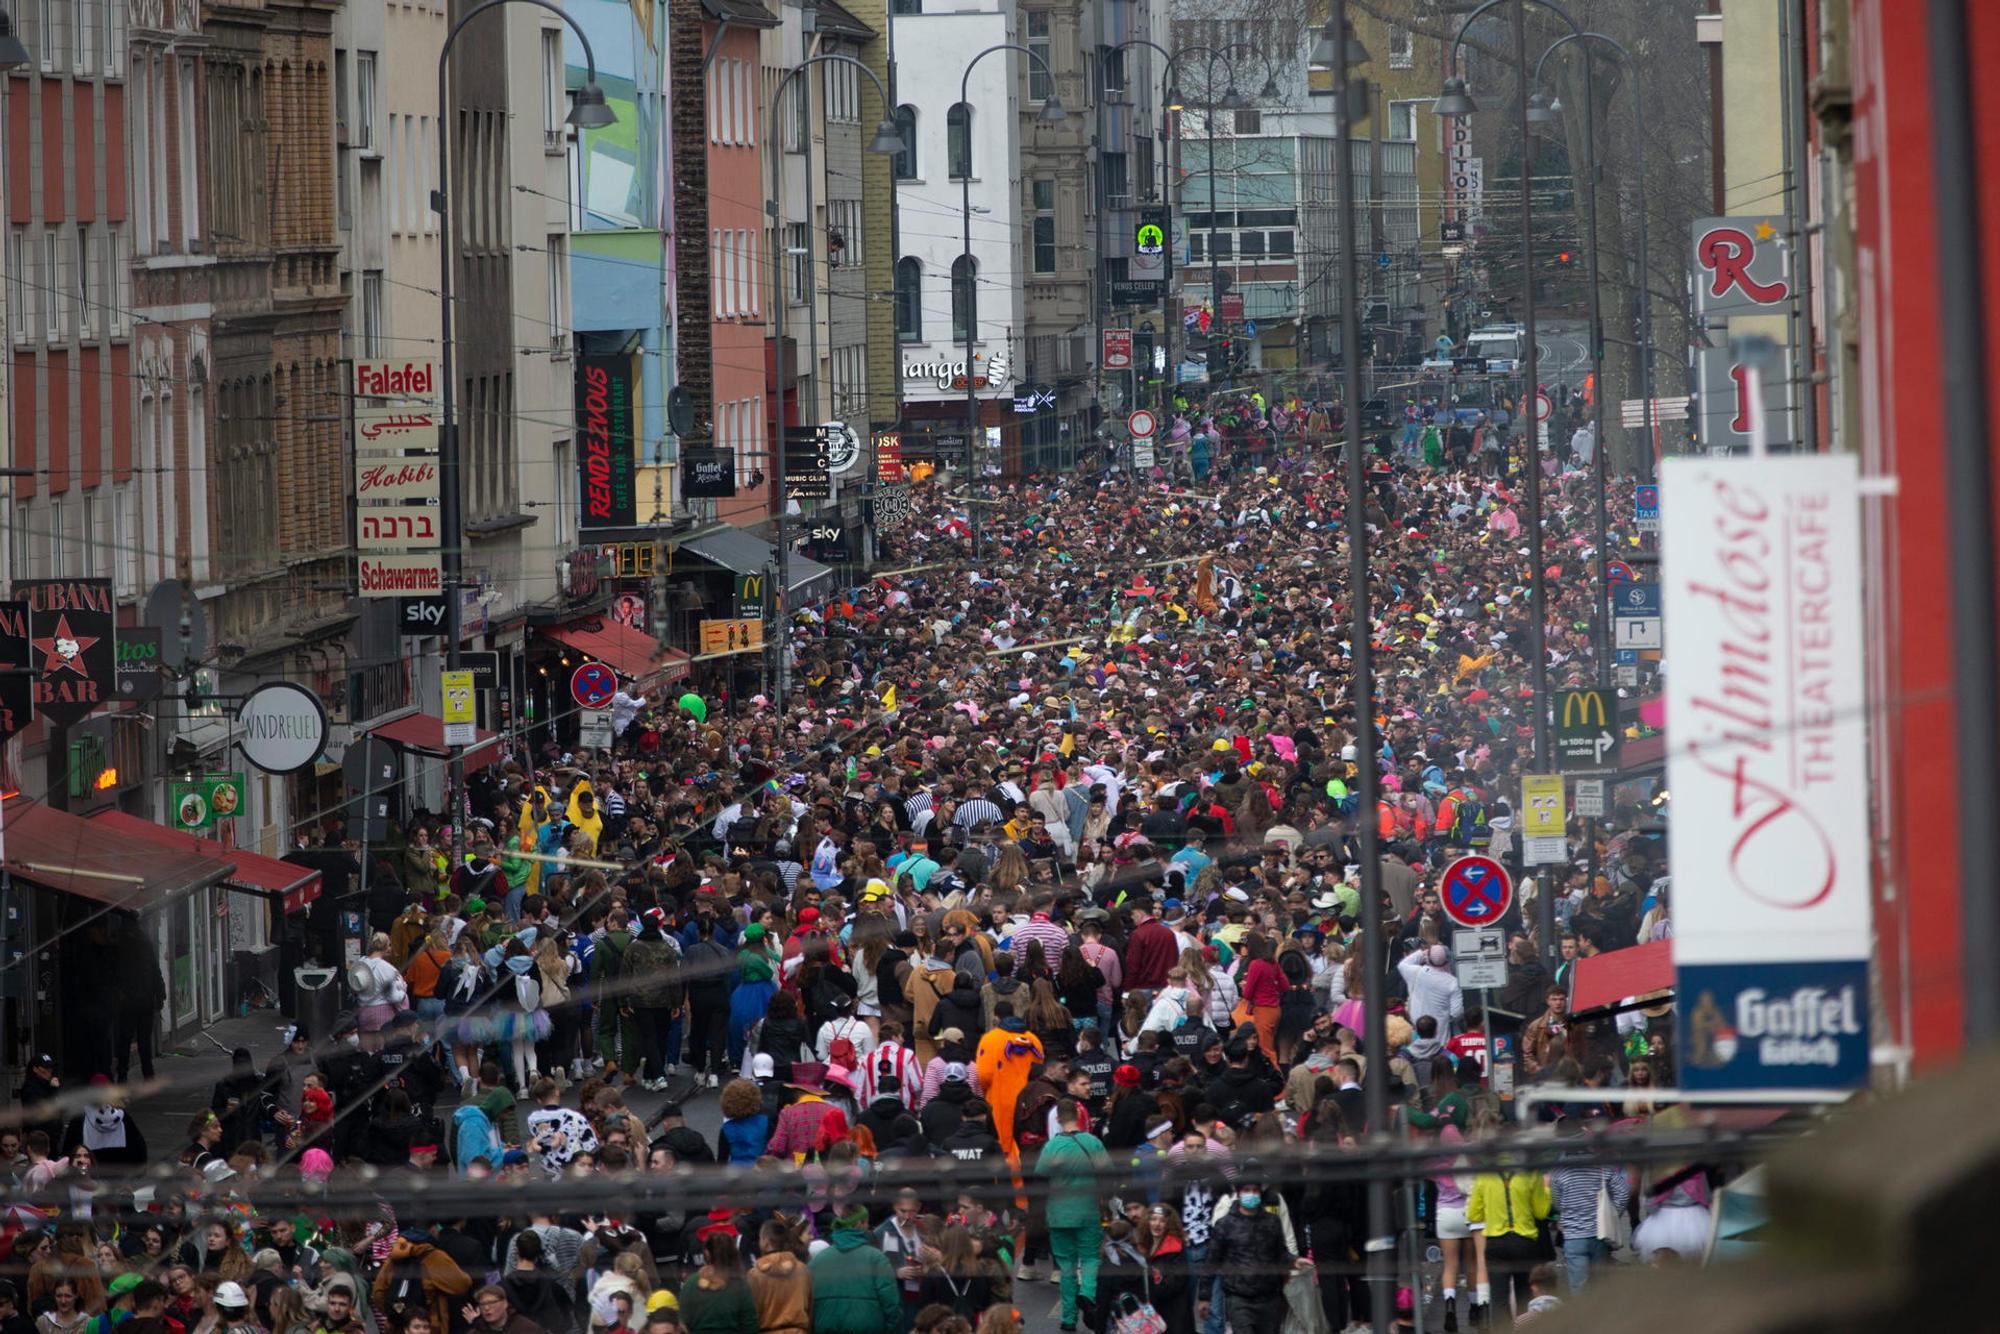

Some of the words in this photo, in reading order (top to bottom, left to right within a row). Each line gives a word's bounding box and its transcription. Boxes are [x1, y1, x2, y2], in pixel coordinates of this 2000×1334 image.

[358, 363, 433, 395] Falafel
[586, 366, 613, 518] RENDEZVOUS
[360, 463, 434, 491] Habibi
[363, 515, 434, 538] ברכה
[812, 525, 840, 541] sky
[361, 561, 439, 590] Schawarma
[15, 582, 112, 614] CUBANA
[406, 601, 446, 625] sky
[32, 680, 98, 702] BAR
[242, 714, 318, 740] WNDRFUEL
[1567, 748, 1593, 756] rechts
[1736, 987, 1859, 1037] Gaffel
